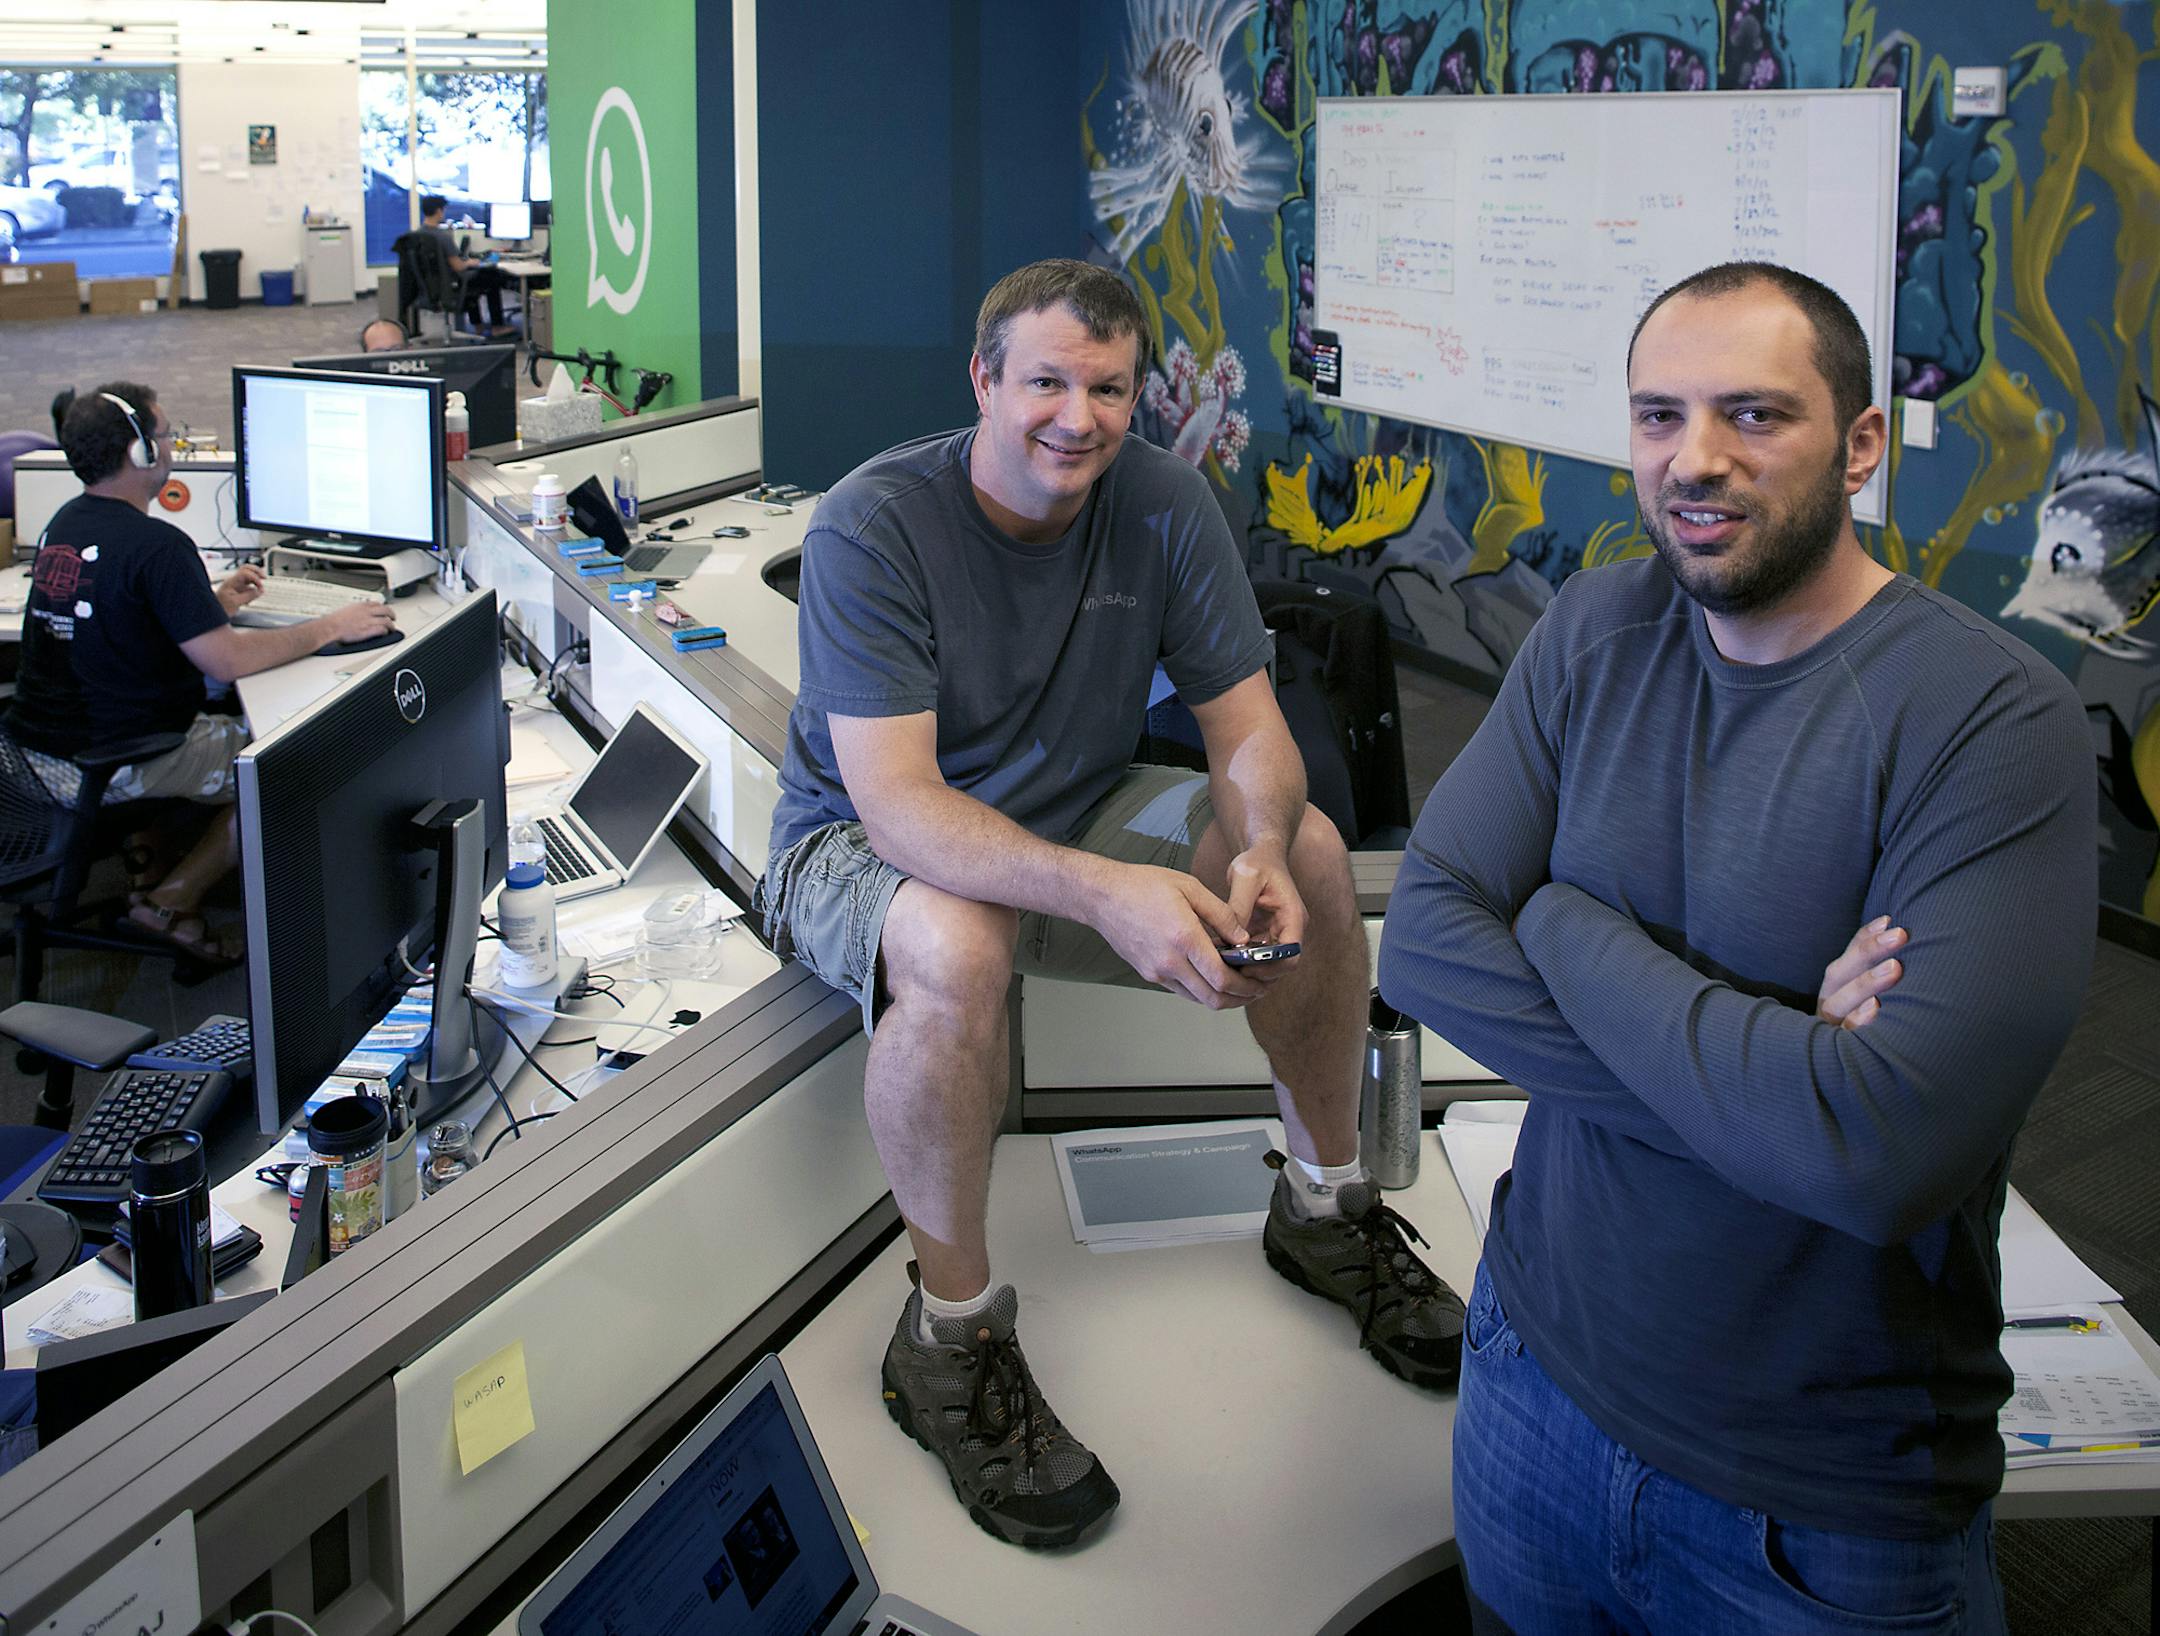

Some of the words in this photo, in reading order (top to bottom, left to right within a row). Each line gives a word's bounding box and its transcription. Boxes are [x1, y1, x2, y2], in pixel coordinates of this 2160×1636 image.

[388, 359, 430, 374] DELL
[400, 684, 422, 708] DELL
[1072, 1146, 1122, 1156] WhatsApp
[1074, 1151, 1150, 1164] Communication
[1151, 1148, 1192, 1158] Strategy
[96, 1592, 139, 1630] WhatsApp
